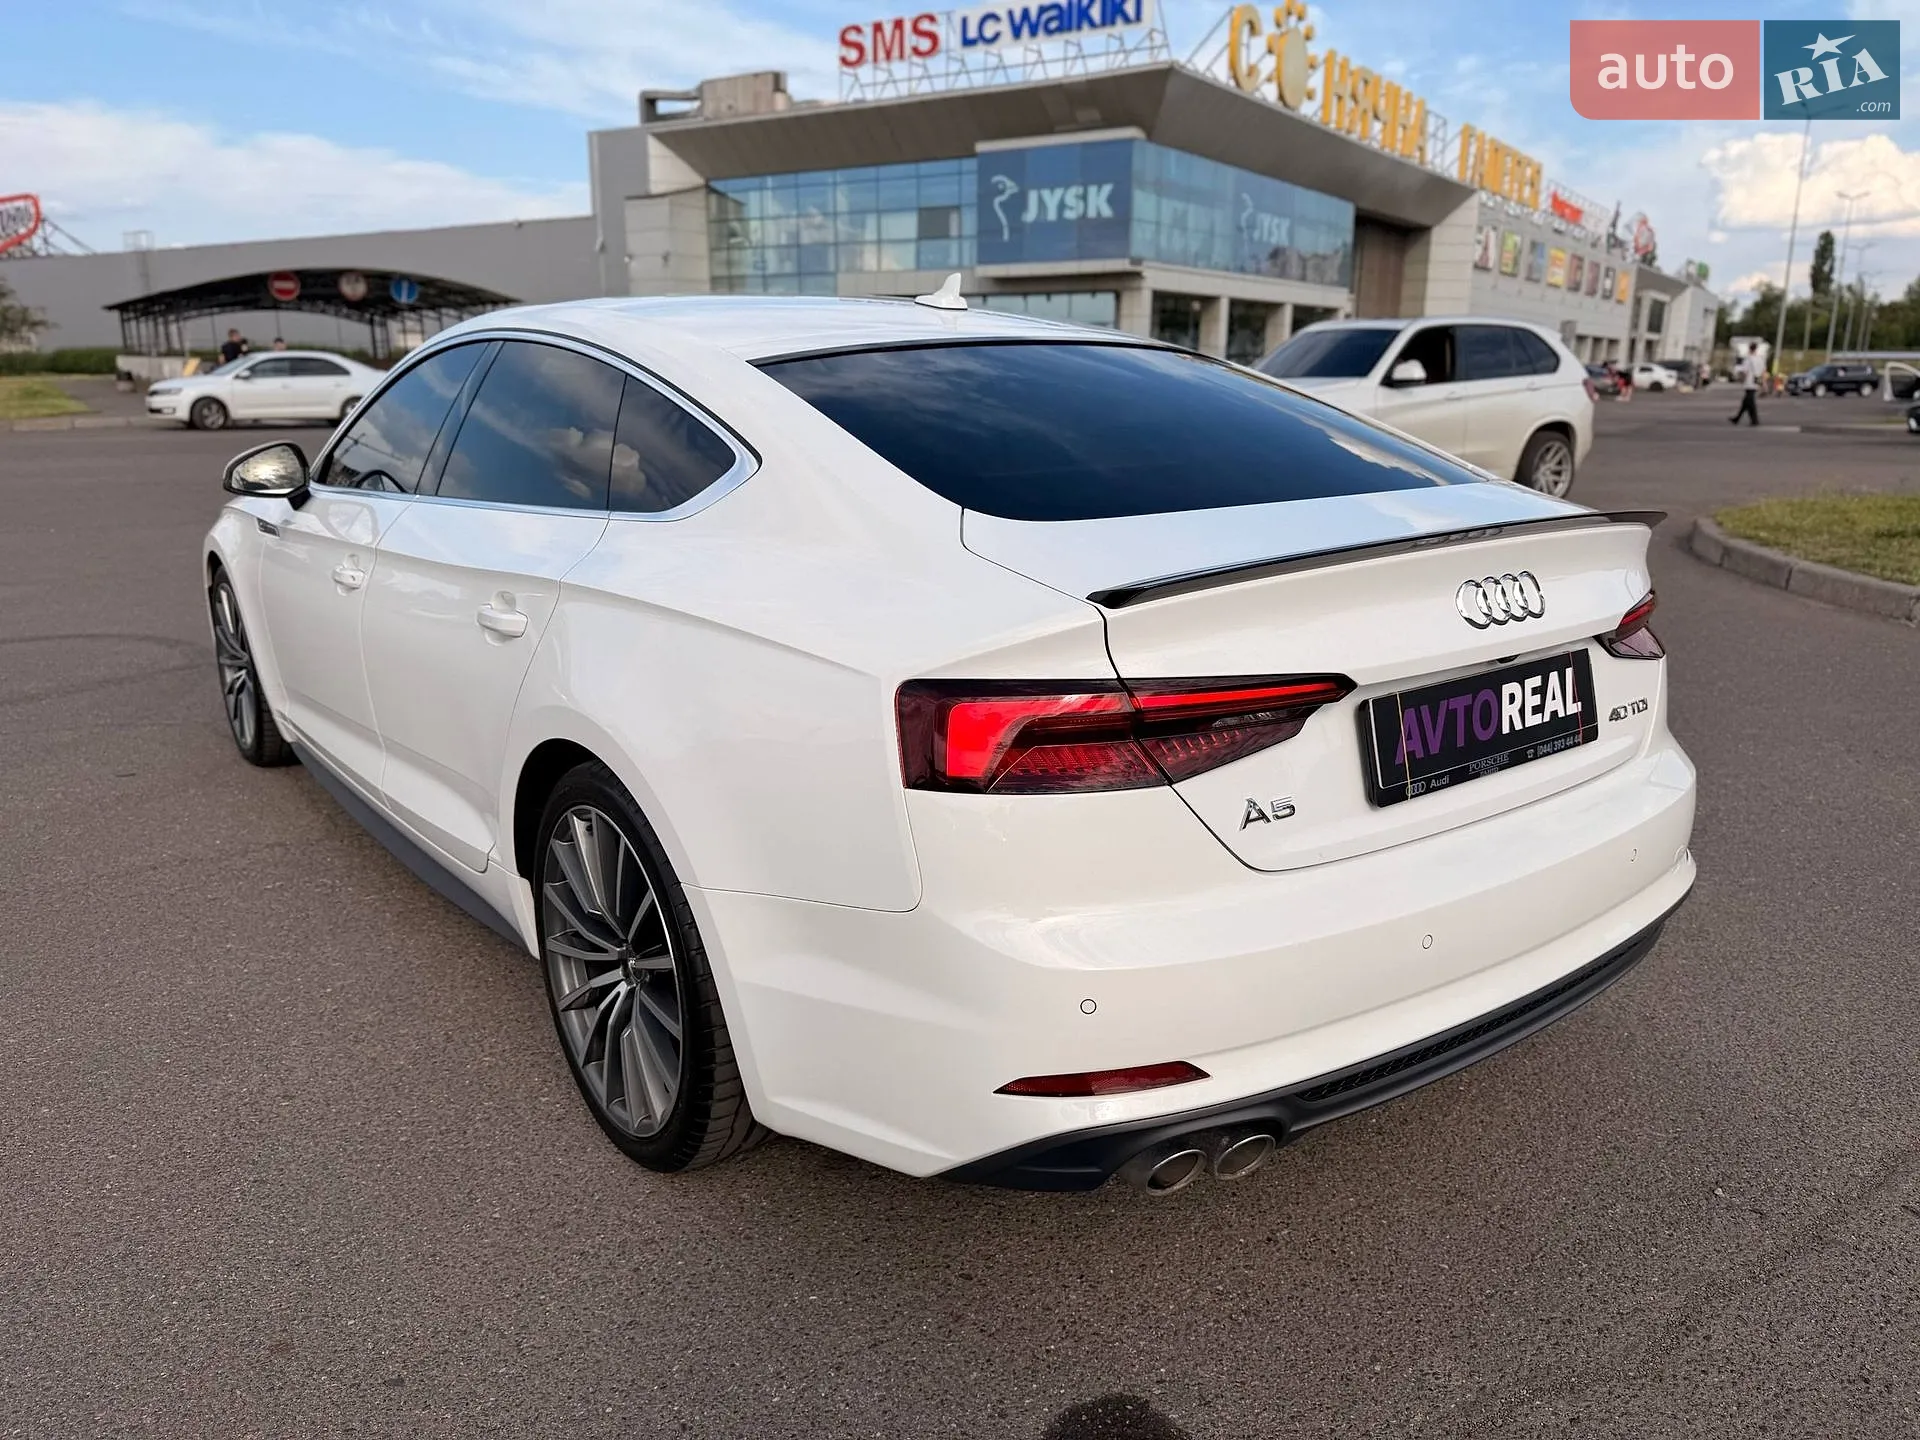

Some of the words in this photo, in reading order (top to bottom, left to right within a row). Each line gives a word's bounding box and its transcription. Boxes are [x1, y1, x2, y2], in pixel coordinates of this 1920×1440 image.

[839, 13, 940, 68] SMS
[961, 13, 1001, 47] LC
[1022, 183, 1114, 223] JYSK
[1609, 705, 1628, 721] 40
[1469, 752, 1510, 772] PORSCHE
[1430, 774, 1450, 789] Audi
[1239, 796, 1296, 831] A5
